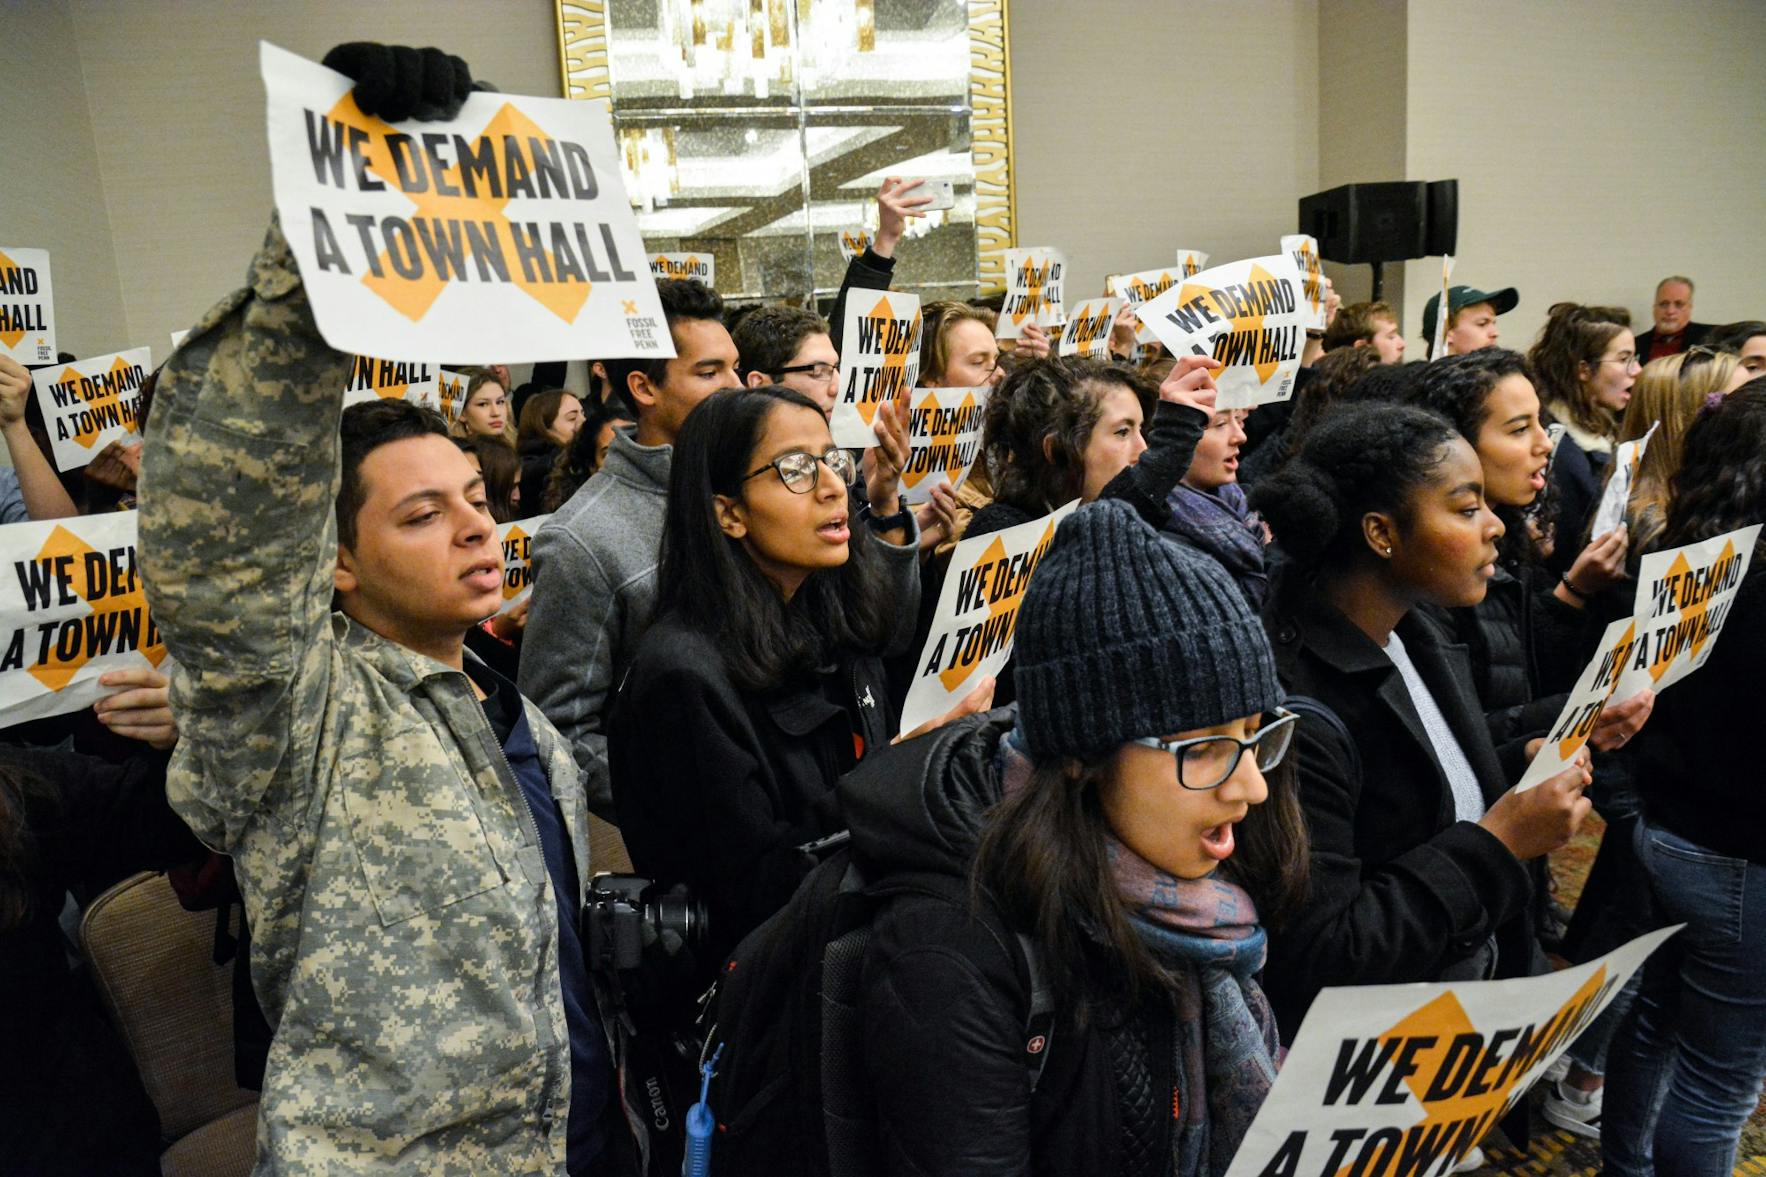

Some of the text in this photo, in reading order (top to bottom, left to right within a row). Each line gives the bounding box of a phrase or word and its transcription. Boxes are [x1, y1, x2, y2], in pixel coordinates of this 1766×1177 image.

[304, 107, 599, 201] WE DEMAND
[310, 206, 637, 284] A TOWN HALL
[0, 267, 38, 295] AND
[667, 261, 708, 276] DEMAND
[1016, 267, 1030, 288] WE
[1005, 294, 1015, 314] A
[1124, 285, 1142, 303] WE
[1165, 295, 1220, 334] WE
[1208, 278, 1296, 320] DEMAND
[626, 317, 658, 328] FOSSIL
[630, 329, 653, 339] FREE
[858, 315, 886, 355] WE
[1066, 319, 1084, 344] WE
[1077, 314, 1112, 343] DEMAND
[634, 339, 659, 350] PENN
[1258, 325, 1297, 365] HALL
[49, 365, 144, 408] WE DEMAND
[379, 360, 431, 388] HALL
[843, 366, 857, 403] A
[861, 366, 902, 403] TOWN
[56, 416, 70, 441] A
[68, 403, 121, 437] TOWN
[909, 405, 982, 437] WE DEMAND
[905, 440, 977, 473] TOWN HALL
[15, 545, 145, 612] WE DEM
[955, 537, 1050, 617] WE DEM
[1652, 553, 1742, 619] WE DEMAND
[0, 628, 25, 672] A
[37, 607, 142, 666] TOWN
[922, 608, 1015, 677] A TOWN
[1633, 632, 1649, 671] A
[1653, 614, 1702, 666] TOWN
[1590, 644, 1625, 692] WE
[1550, 706, 1580, 744] A
[1322, 1034, 1439, 1106] WE
[1423, 974, 1619, 1103] DEMAND
[646, 1076, 669, 1130] Canon
[1257, 1107, 1495, 1177] A TOWN
